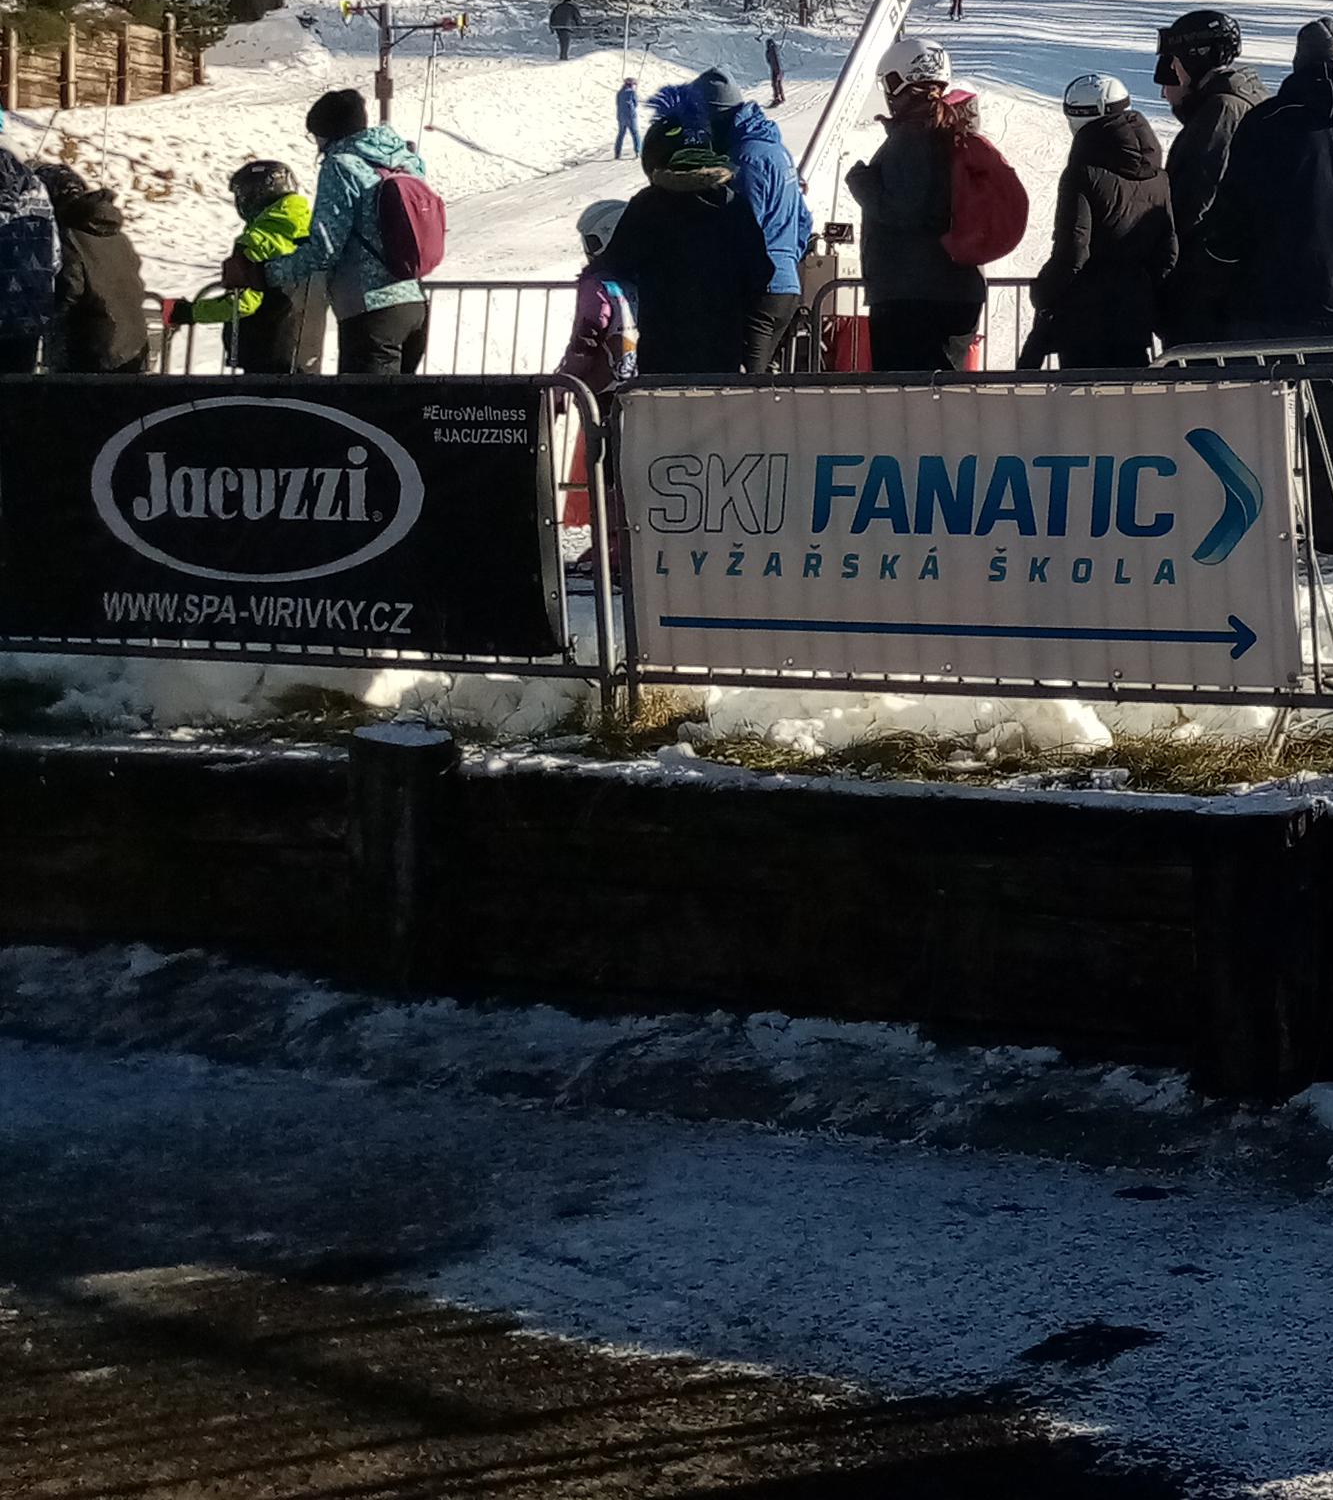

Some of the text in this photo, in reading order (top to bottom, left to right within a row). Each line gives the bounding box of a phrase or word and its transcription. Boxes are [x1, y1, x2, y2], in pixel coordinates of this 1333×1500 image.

[422, 405, 526, 421] #EuroWellness
[433, 428, 528, 444] #JACUZZISKI
[647, 452, 1178, 539] SKI FANATIC
[655, 541, 1178, 585] LYŽAŘSKÁ ŠKOLA
[103, 591, 415, 634] WWW.SPA-VIRIVKY.CZ
